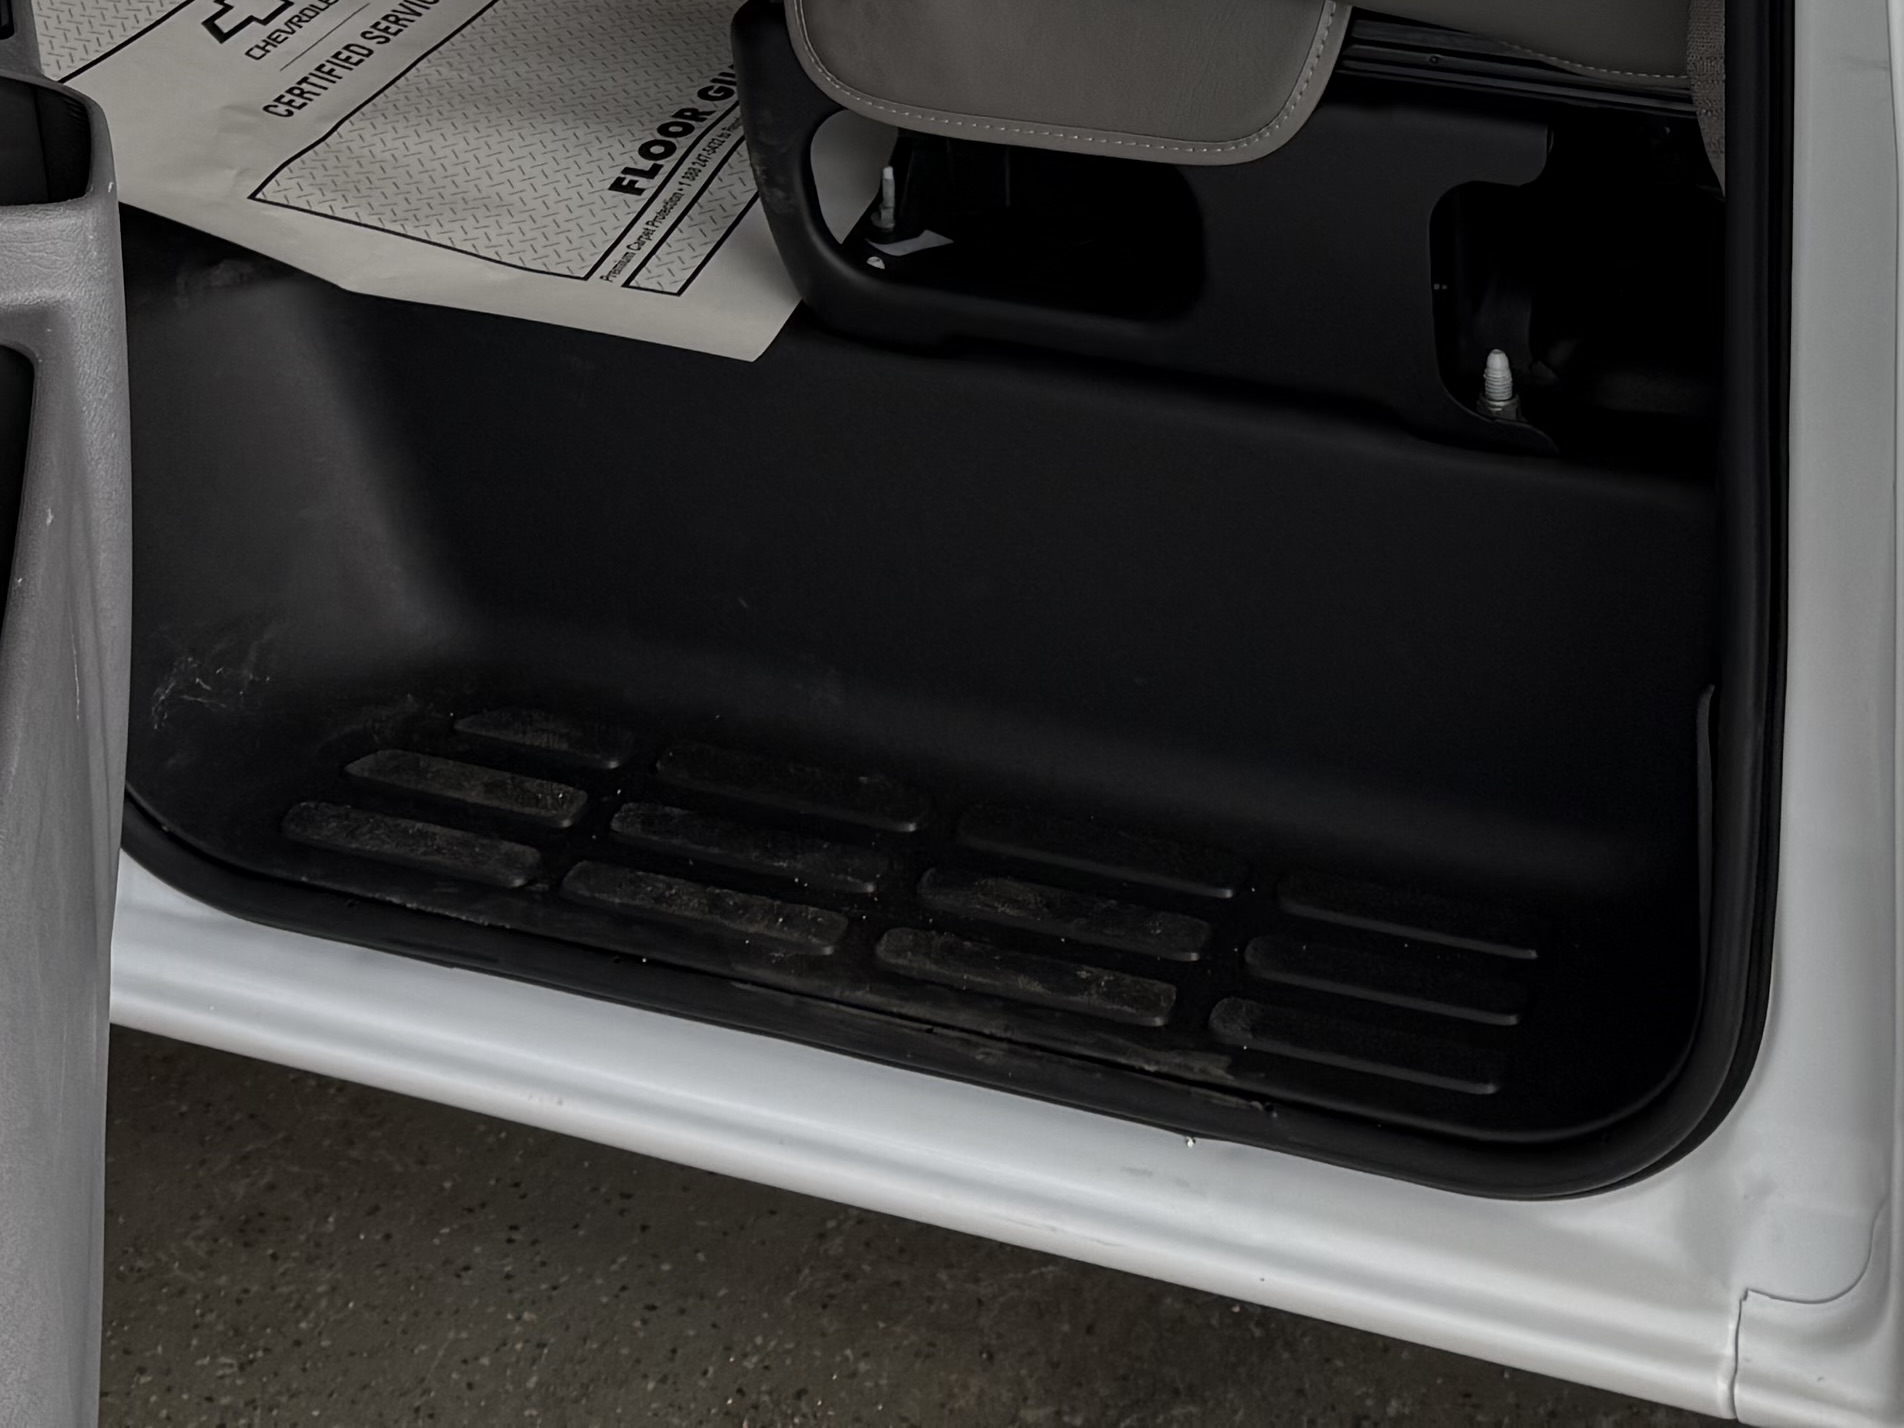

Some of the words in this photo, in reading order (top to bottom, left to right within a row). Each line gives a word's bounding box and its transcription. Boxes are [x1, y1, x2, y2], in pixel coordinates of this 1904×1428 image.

[262, 43, 374, 118] CERTIFIED
[608, 108, 717, 196] FLOOR
[600, 251, 636, 282] Premium
[627, 227, 655, 251] Carpet
[646, 191, 683, 228] Protection
